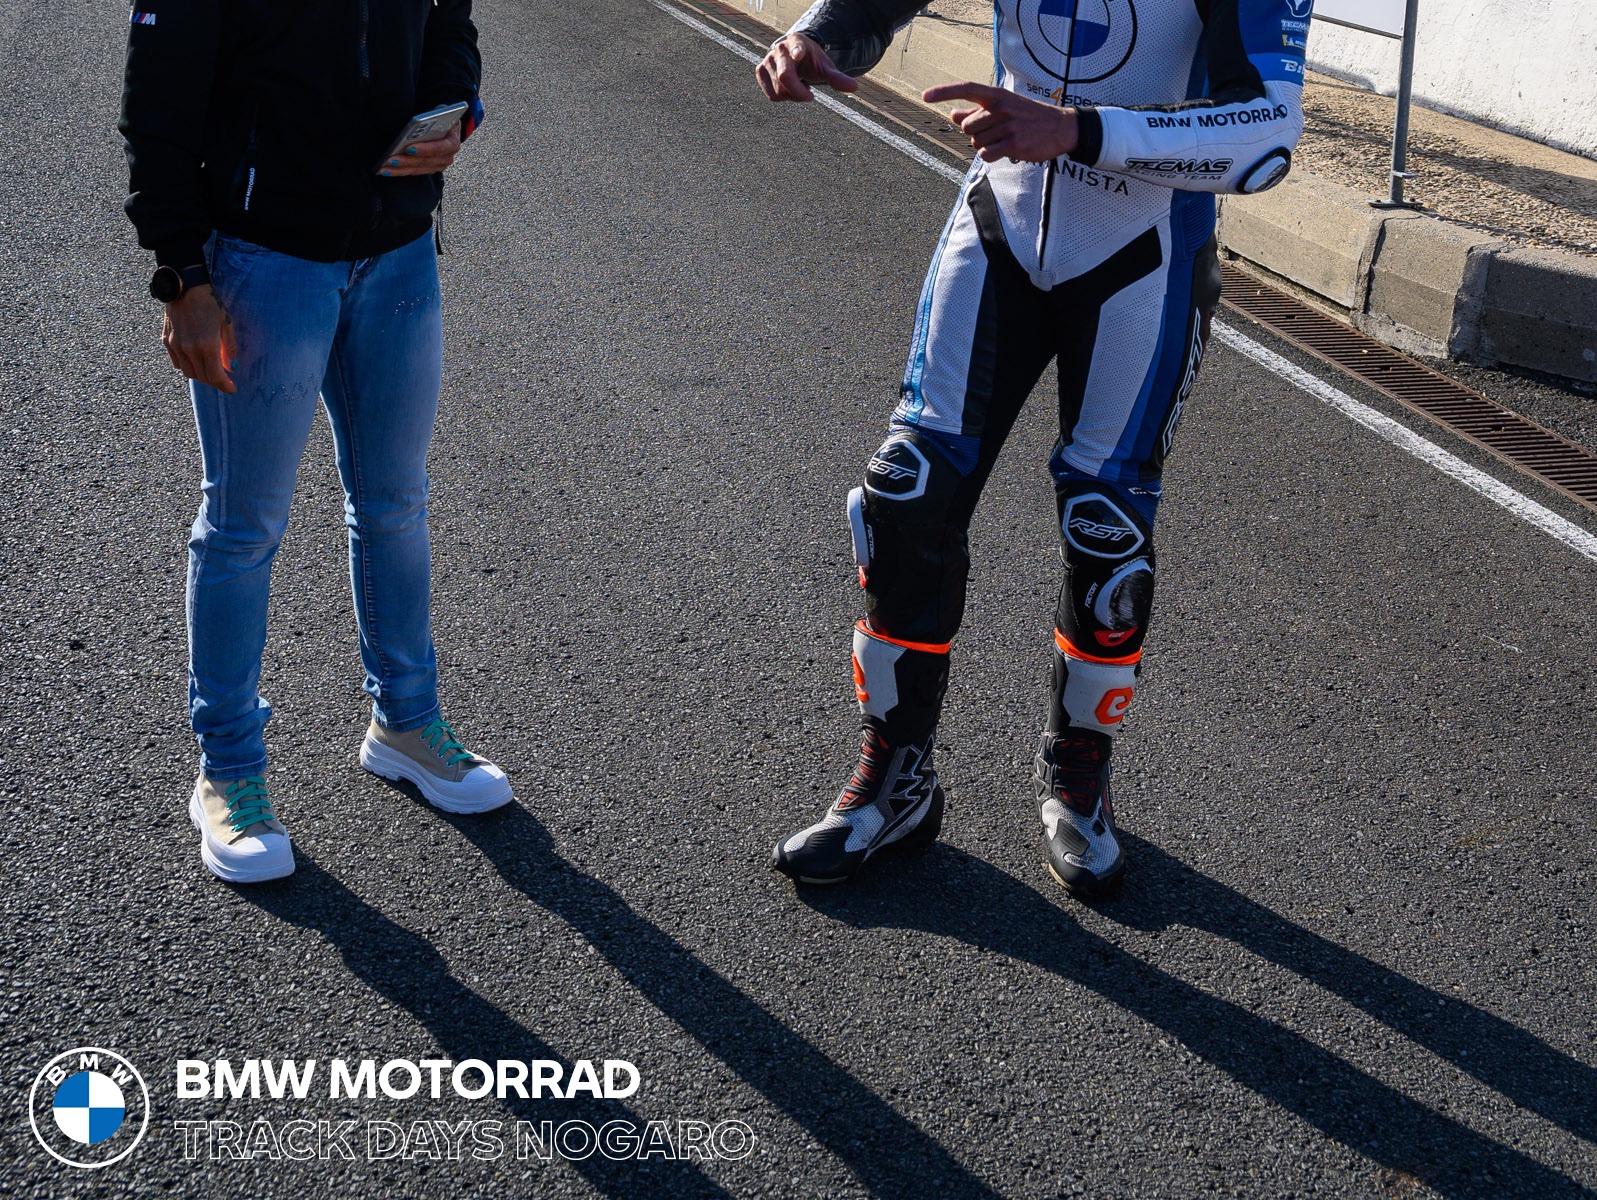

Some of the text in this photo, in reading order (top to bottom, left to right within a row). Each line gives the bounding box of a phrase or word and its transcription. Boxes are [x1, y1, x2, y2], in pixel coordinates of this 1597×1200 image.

[1281, 19, 1310, 31] TECM
[1147, 103, 1288, 129] BMW MOTORRAD
[1126, 158, 1233, 175] TECMAS
[1069, 517, 1133, 541] RST
